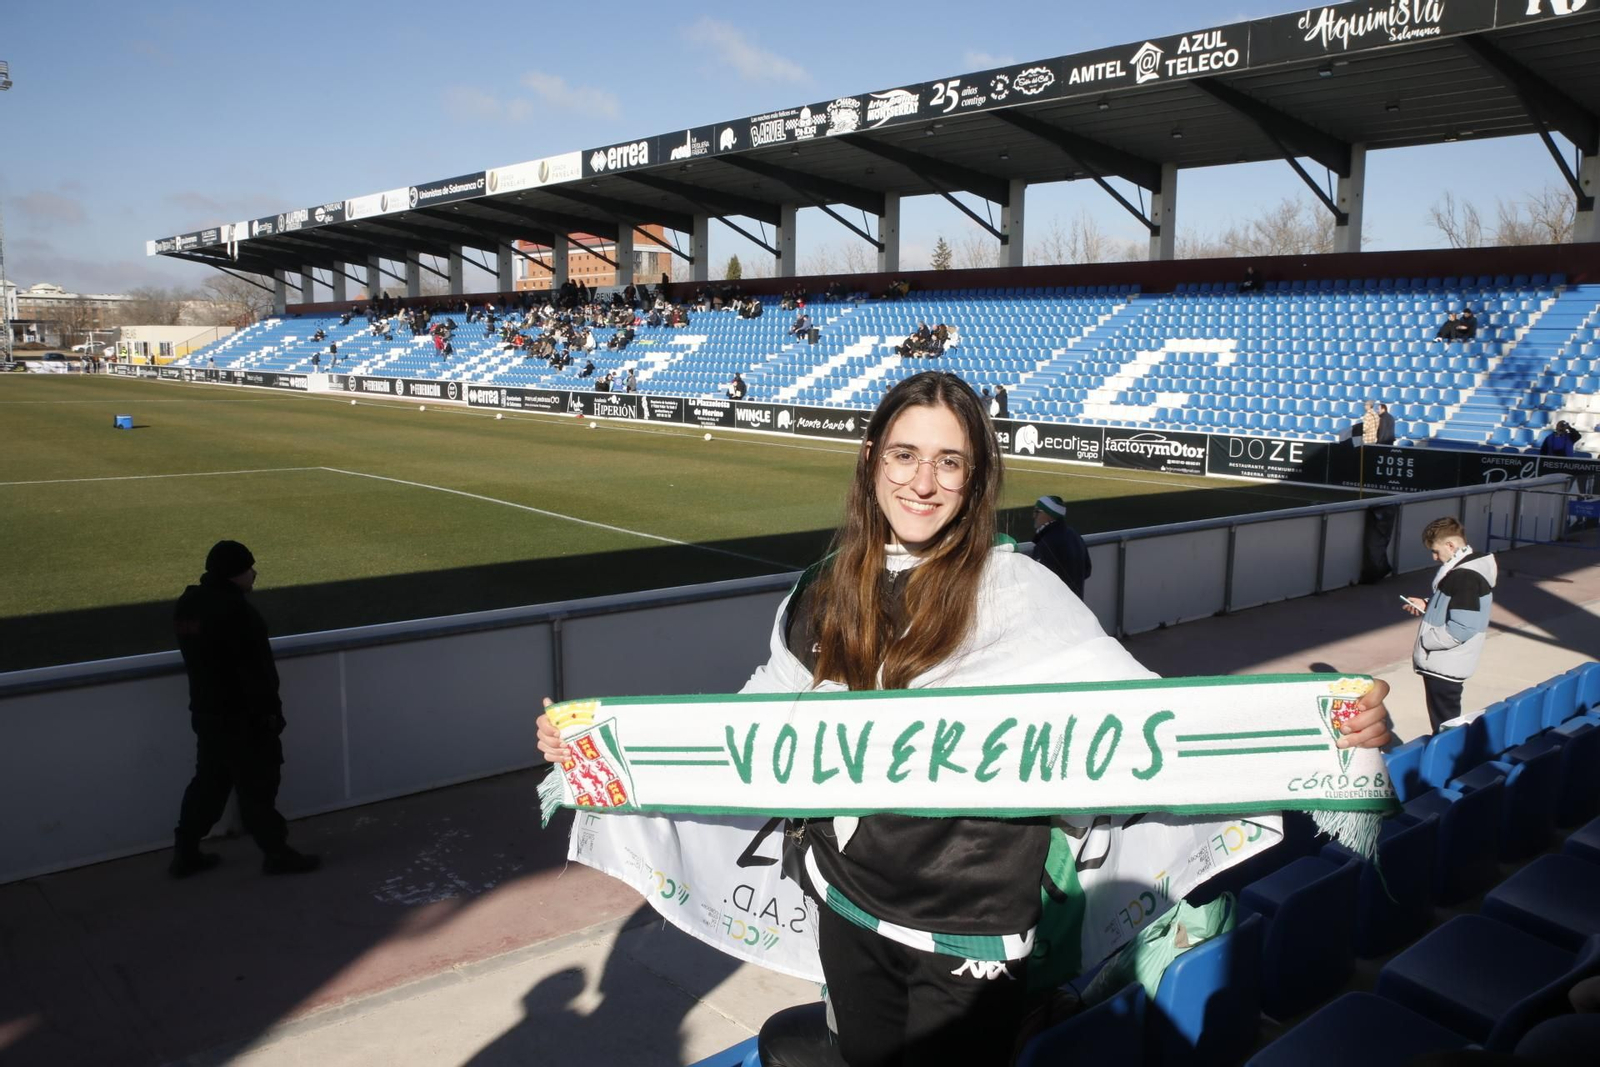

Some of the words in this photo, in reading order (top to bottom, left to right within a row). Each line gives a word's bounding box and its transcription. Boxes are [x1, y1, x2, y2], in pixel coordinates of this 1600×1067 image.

[1298, 10, 1311, 30] el
[1177, 30, 1228, 54] AZUL
[1388, 26, 1441, 42] Salamanca
[1165, 48, 1240, 77] TELECO
[1069, 60, 1127, 85] AMTEL
[929, 79, 961, 113] 25
[961, 86, 979, 98] años
[961, 94, 987, 107] contigo
[751, 119, 787, 148] BARVEL
[607, 141, 649, 170] errea
[419, 187, 443, 200] Unionistas
[442, 186, 449, 195] de
[449, 181, 476, 195] Salamanca
[476, 178, 485, 189] CF
[478, 389, 499, 406] errea
[688, 398, 696, 406] La
[594, 403, 637, 419] HIPERIÓN
[694, 408, 701, 416] de
[702, 408, 724, 418] Merino
[797, 417, 822, 429] Monte
[822, 418, 845, 432] Carlo
[1077, 451, 1098, 460] grupo
[1229, 437, 1304, 463] DOZE
[1229, 462, 1265, 470] RESTAURANTE
[1377, 455, 1414, 467] JOSE
[1481, 457, 1522, 466] CAFETERÍA
[1543, 461, 1600, 473] RESTAURANTE
[1376, 467, 1414, 478] LUIS
[726, 710, 1175, 786] VOLVEREMOS
